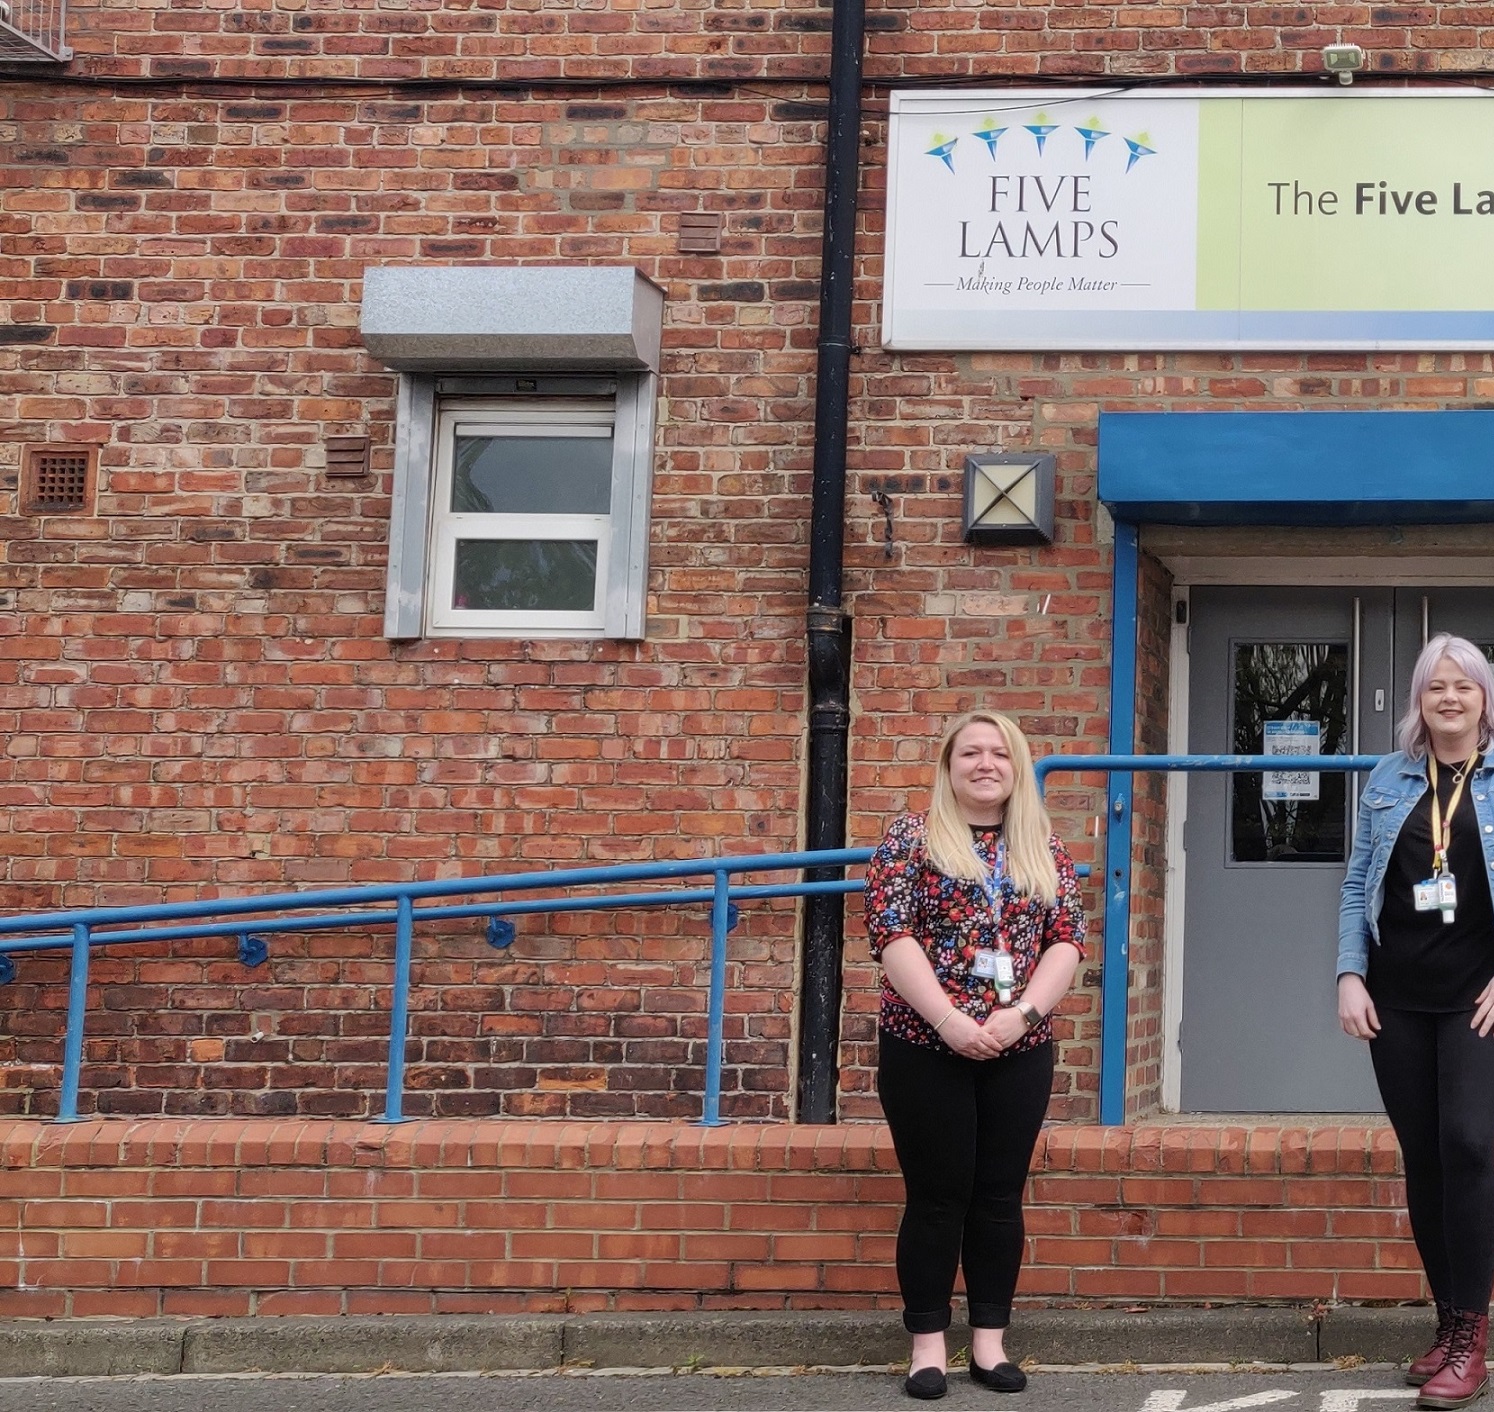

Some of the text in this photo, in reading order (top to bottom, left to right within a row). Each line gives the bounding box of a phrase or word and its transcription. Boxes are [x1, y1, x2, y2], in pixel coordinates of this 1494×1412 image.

[988, 175, 1092, 213] FIVE
[1267, 180, 1339, 216] The
[1355, 180, 1438, 216] Five
[958, 220, 1119, 259] LAMPS
[957, 276, 1117, 295] Making People Matter
